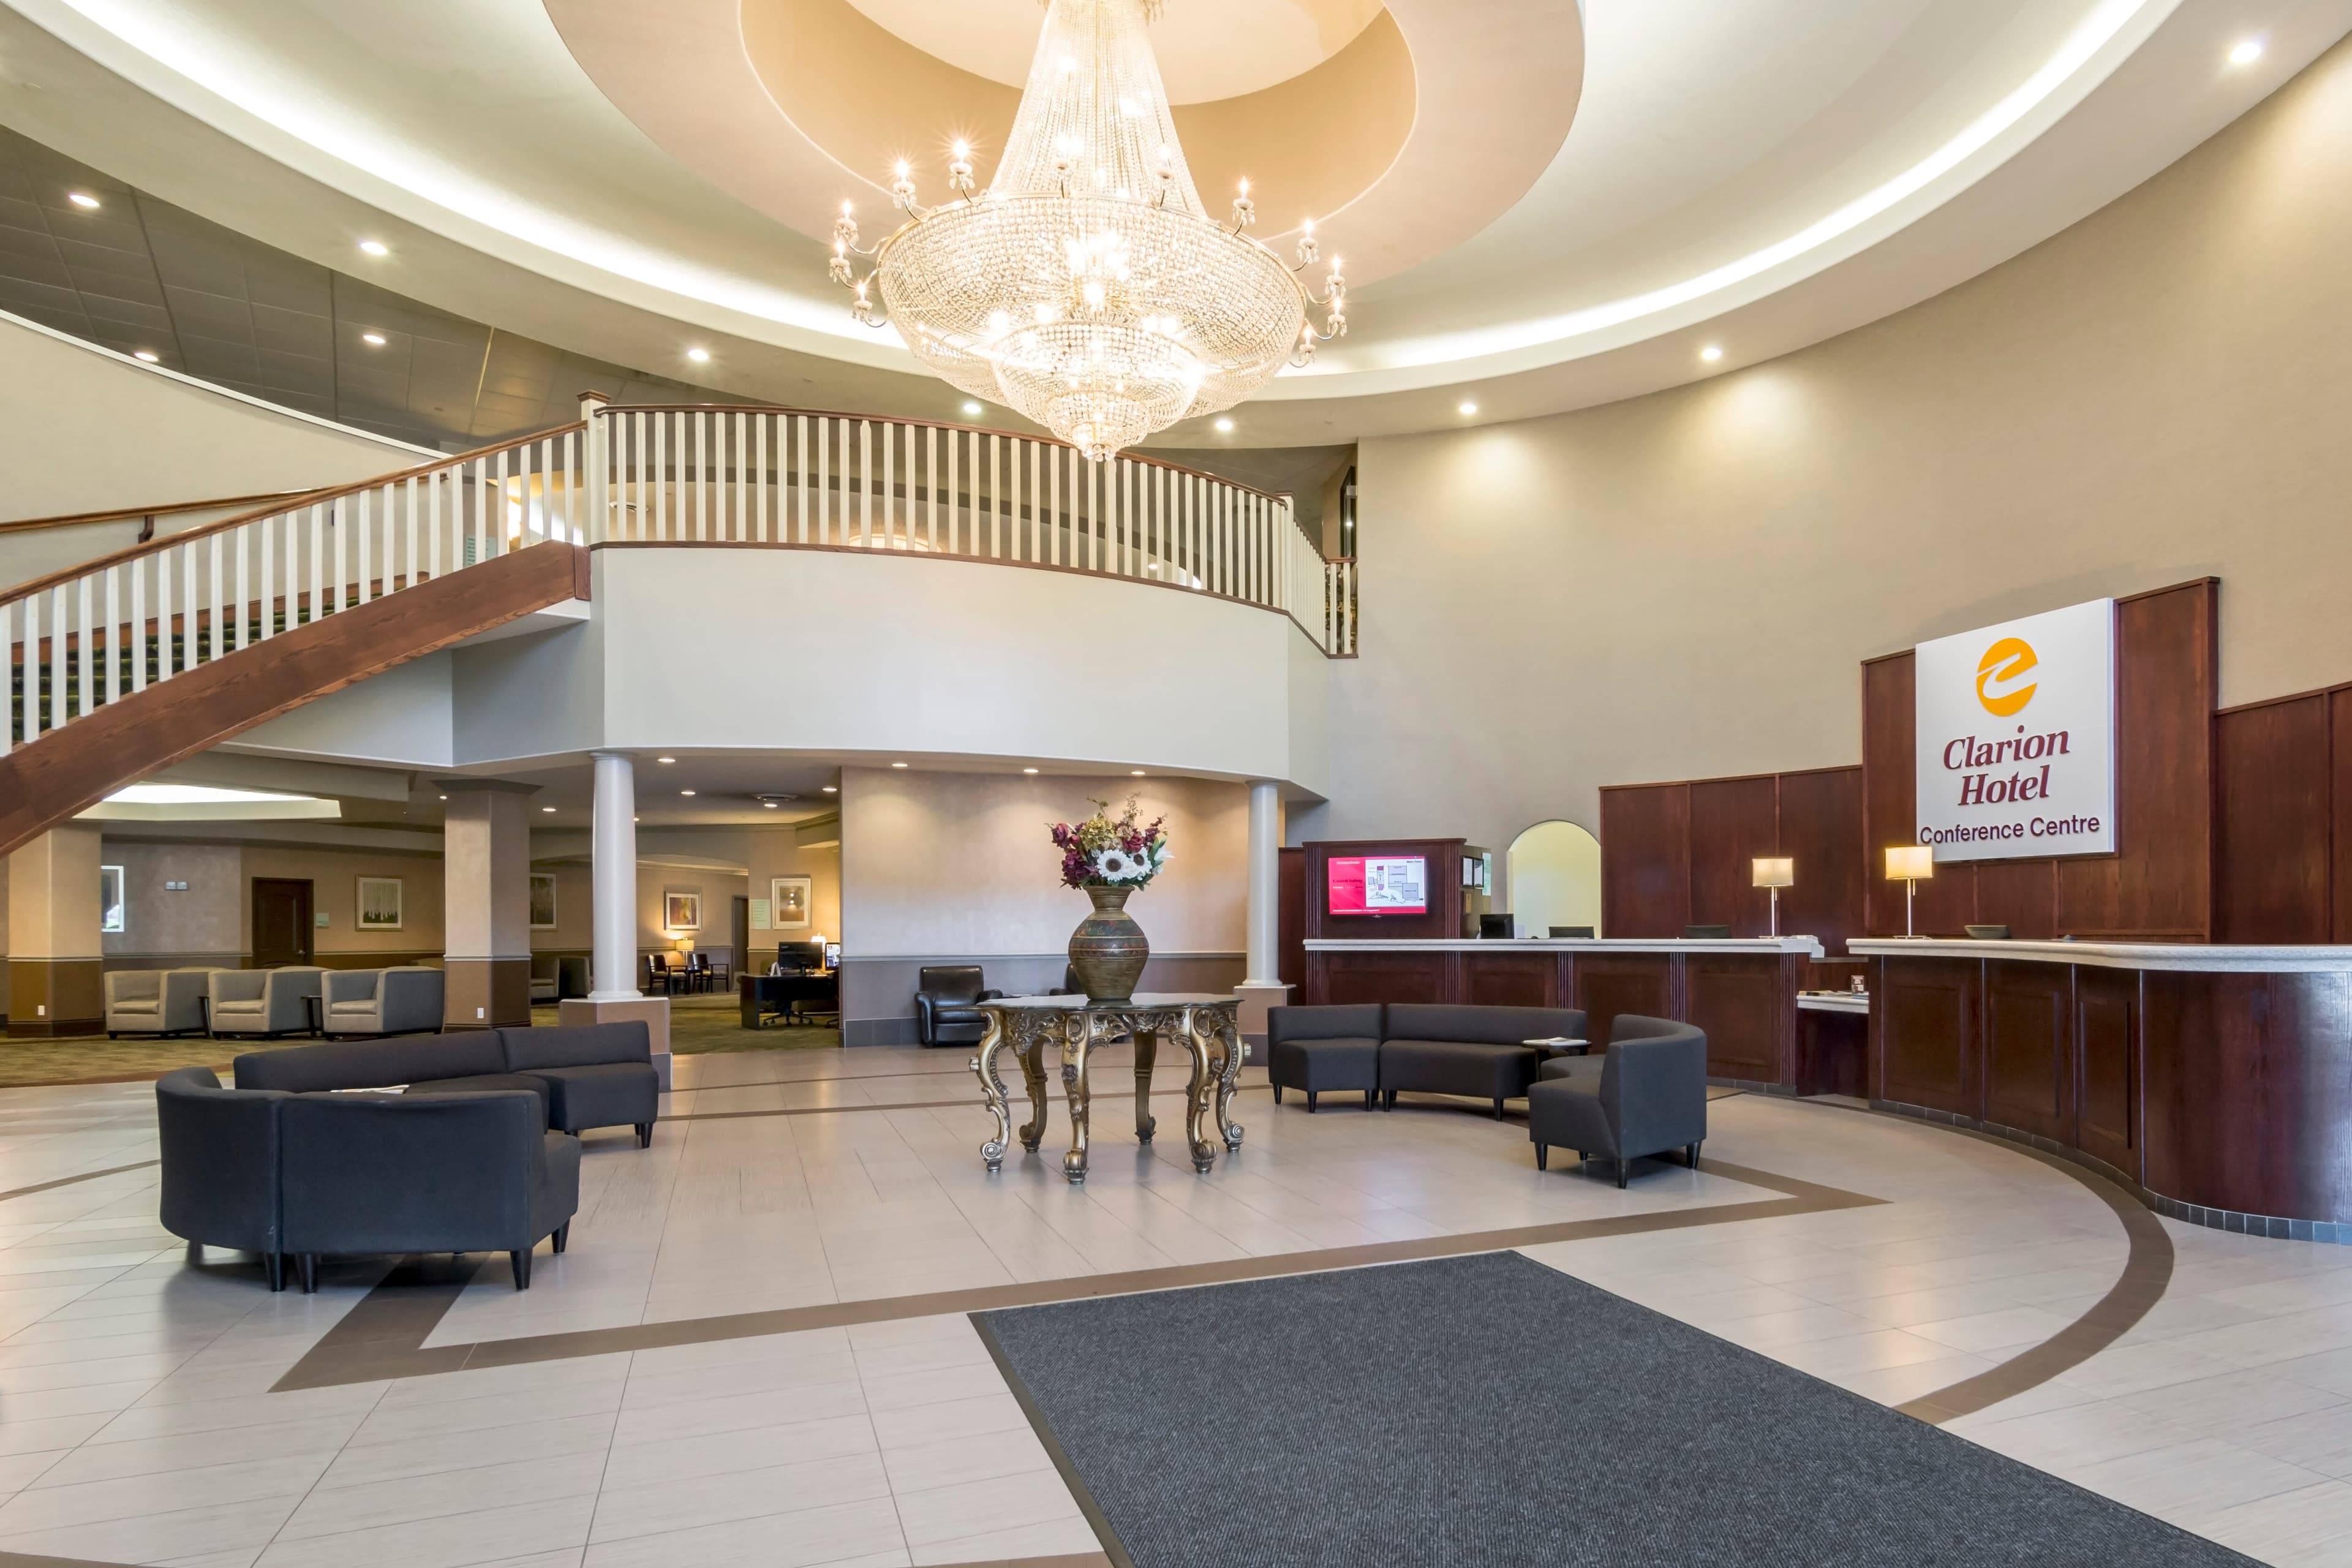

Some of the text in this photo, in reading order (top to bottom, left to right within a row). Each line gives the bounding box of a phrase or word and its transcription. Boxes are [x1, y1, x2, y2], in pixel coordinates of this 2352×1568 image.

[1943, 725, 2070, 770] Clarion
[1958, 764, 2050, 805] Hotel
[1920, 815, 2100, 844] Conference Centre
